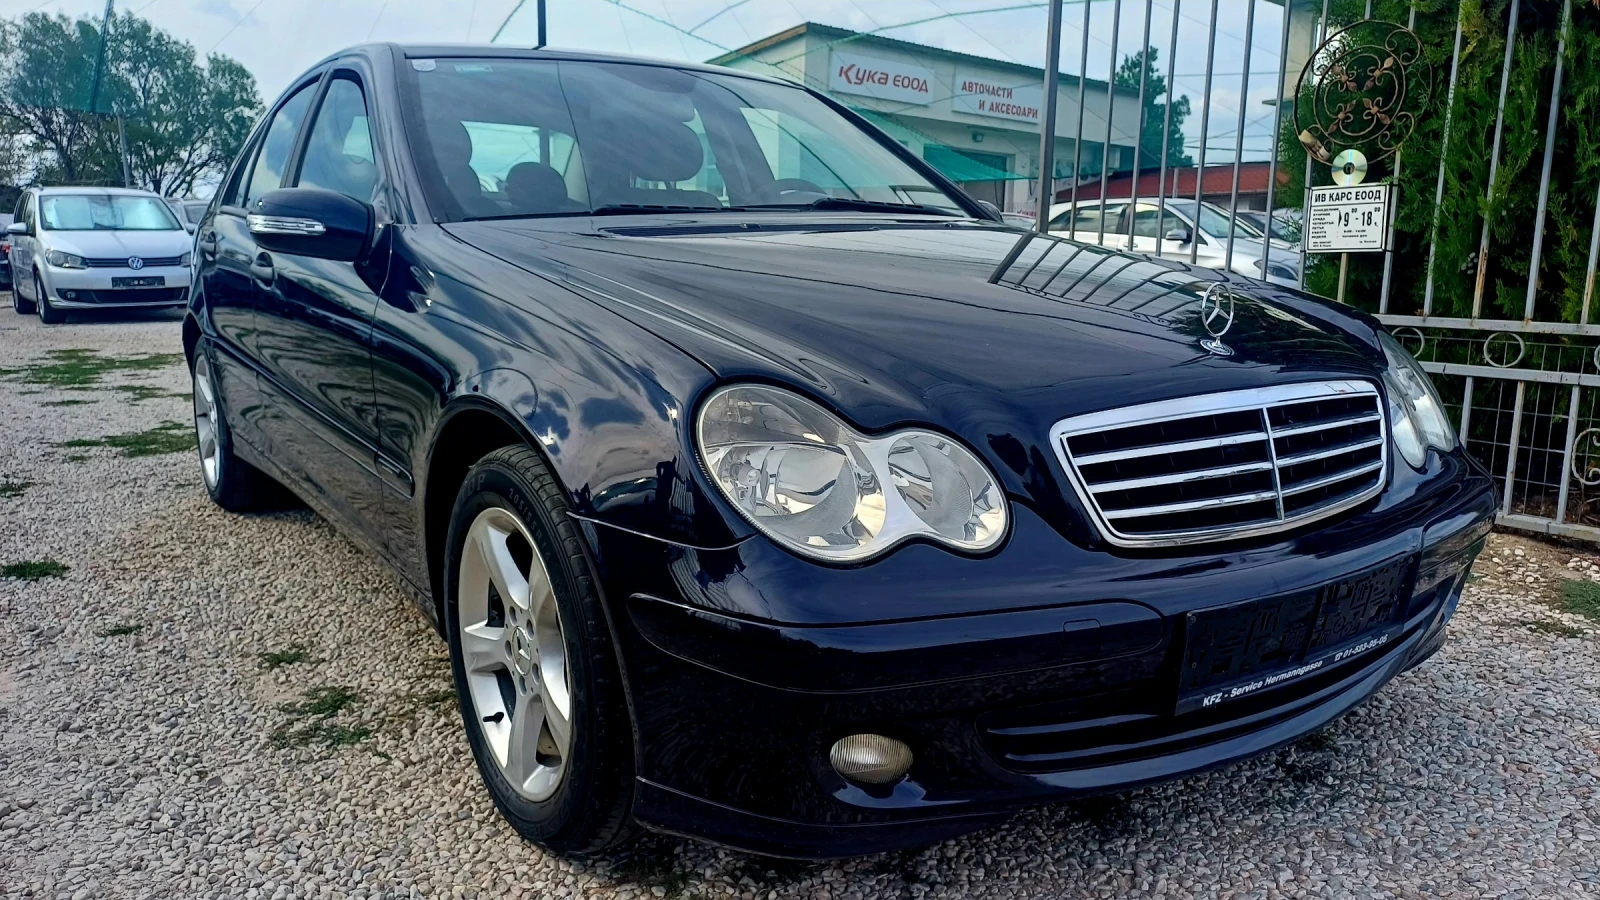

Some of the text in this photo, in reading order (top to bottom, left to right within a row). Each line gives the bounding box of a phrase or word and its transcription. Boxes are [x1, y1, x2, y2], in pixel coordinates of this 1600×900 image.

[961, 80, 1013, 99] АВТОЧАСТИ
[978, 99, 1038, 119] И АКСЕСОАРИ
[1314, 190, 1381, 202] ИВ КАРС ЕООД
[1362, 211, 1372, 226] 18
[1202, 692, 1223, 707] KFZ
[1230, 681, 1263, 698] Service
[1265, 660, 1323, 686] Hermanngasse
